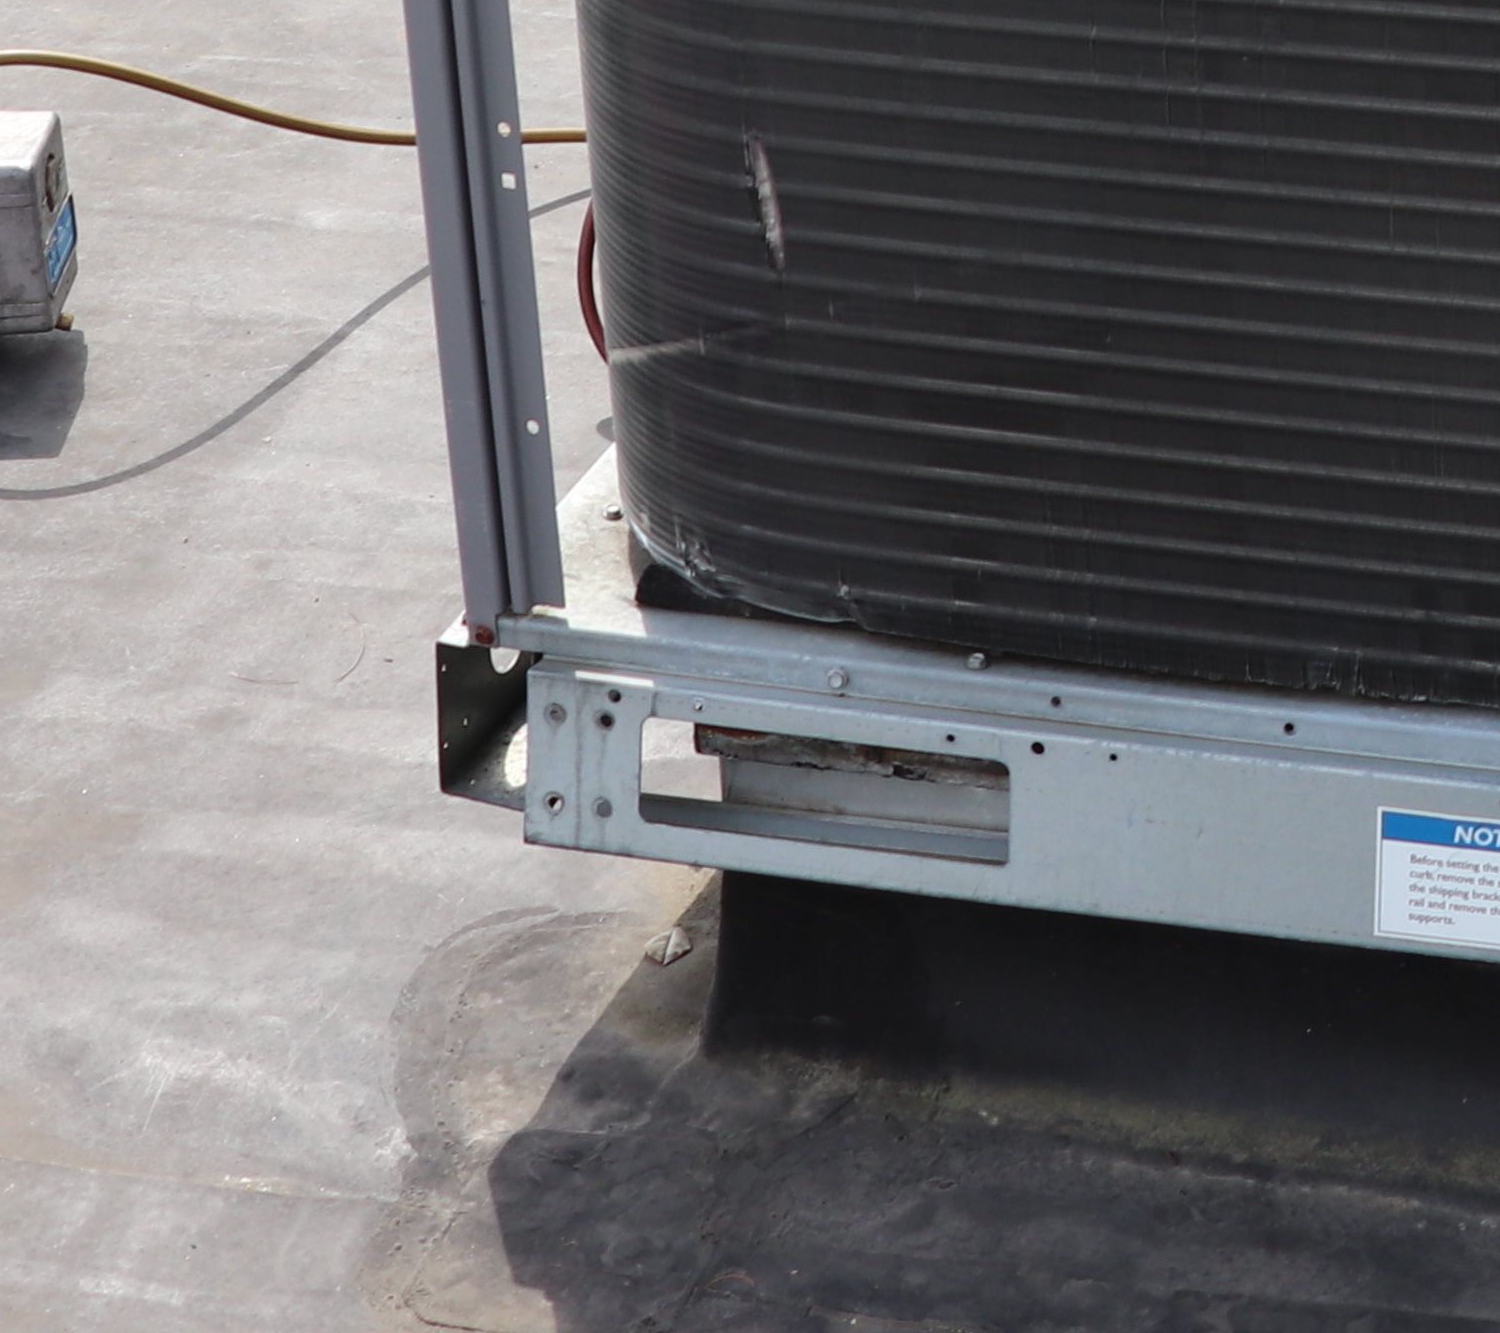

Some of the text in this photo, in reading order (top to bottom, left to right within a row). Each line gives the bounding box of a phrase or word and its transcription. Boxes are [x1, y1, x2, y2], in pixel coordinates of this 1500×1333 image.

[1409, 853, 1444, 868] Before
[1445, 859, 1480, 873] setting
[1482, 862, 1499, 873] the
[1436, 874, 1475, 885] remove
[1478, 877, 1495, 887] the
[1408, 882, 1426, 892] the
[1428, 886, 1470, 901] shipping
[1408, 898, 1426, 908] rail
[1427, 900, 1446, 910] and
[1448, 904, 1487, 915] remove
